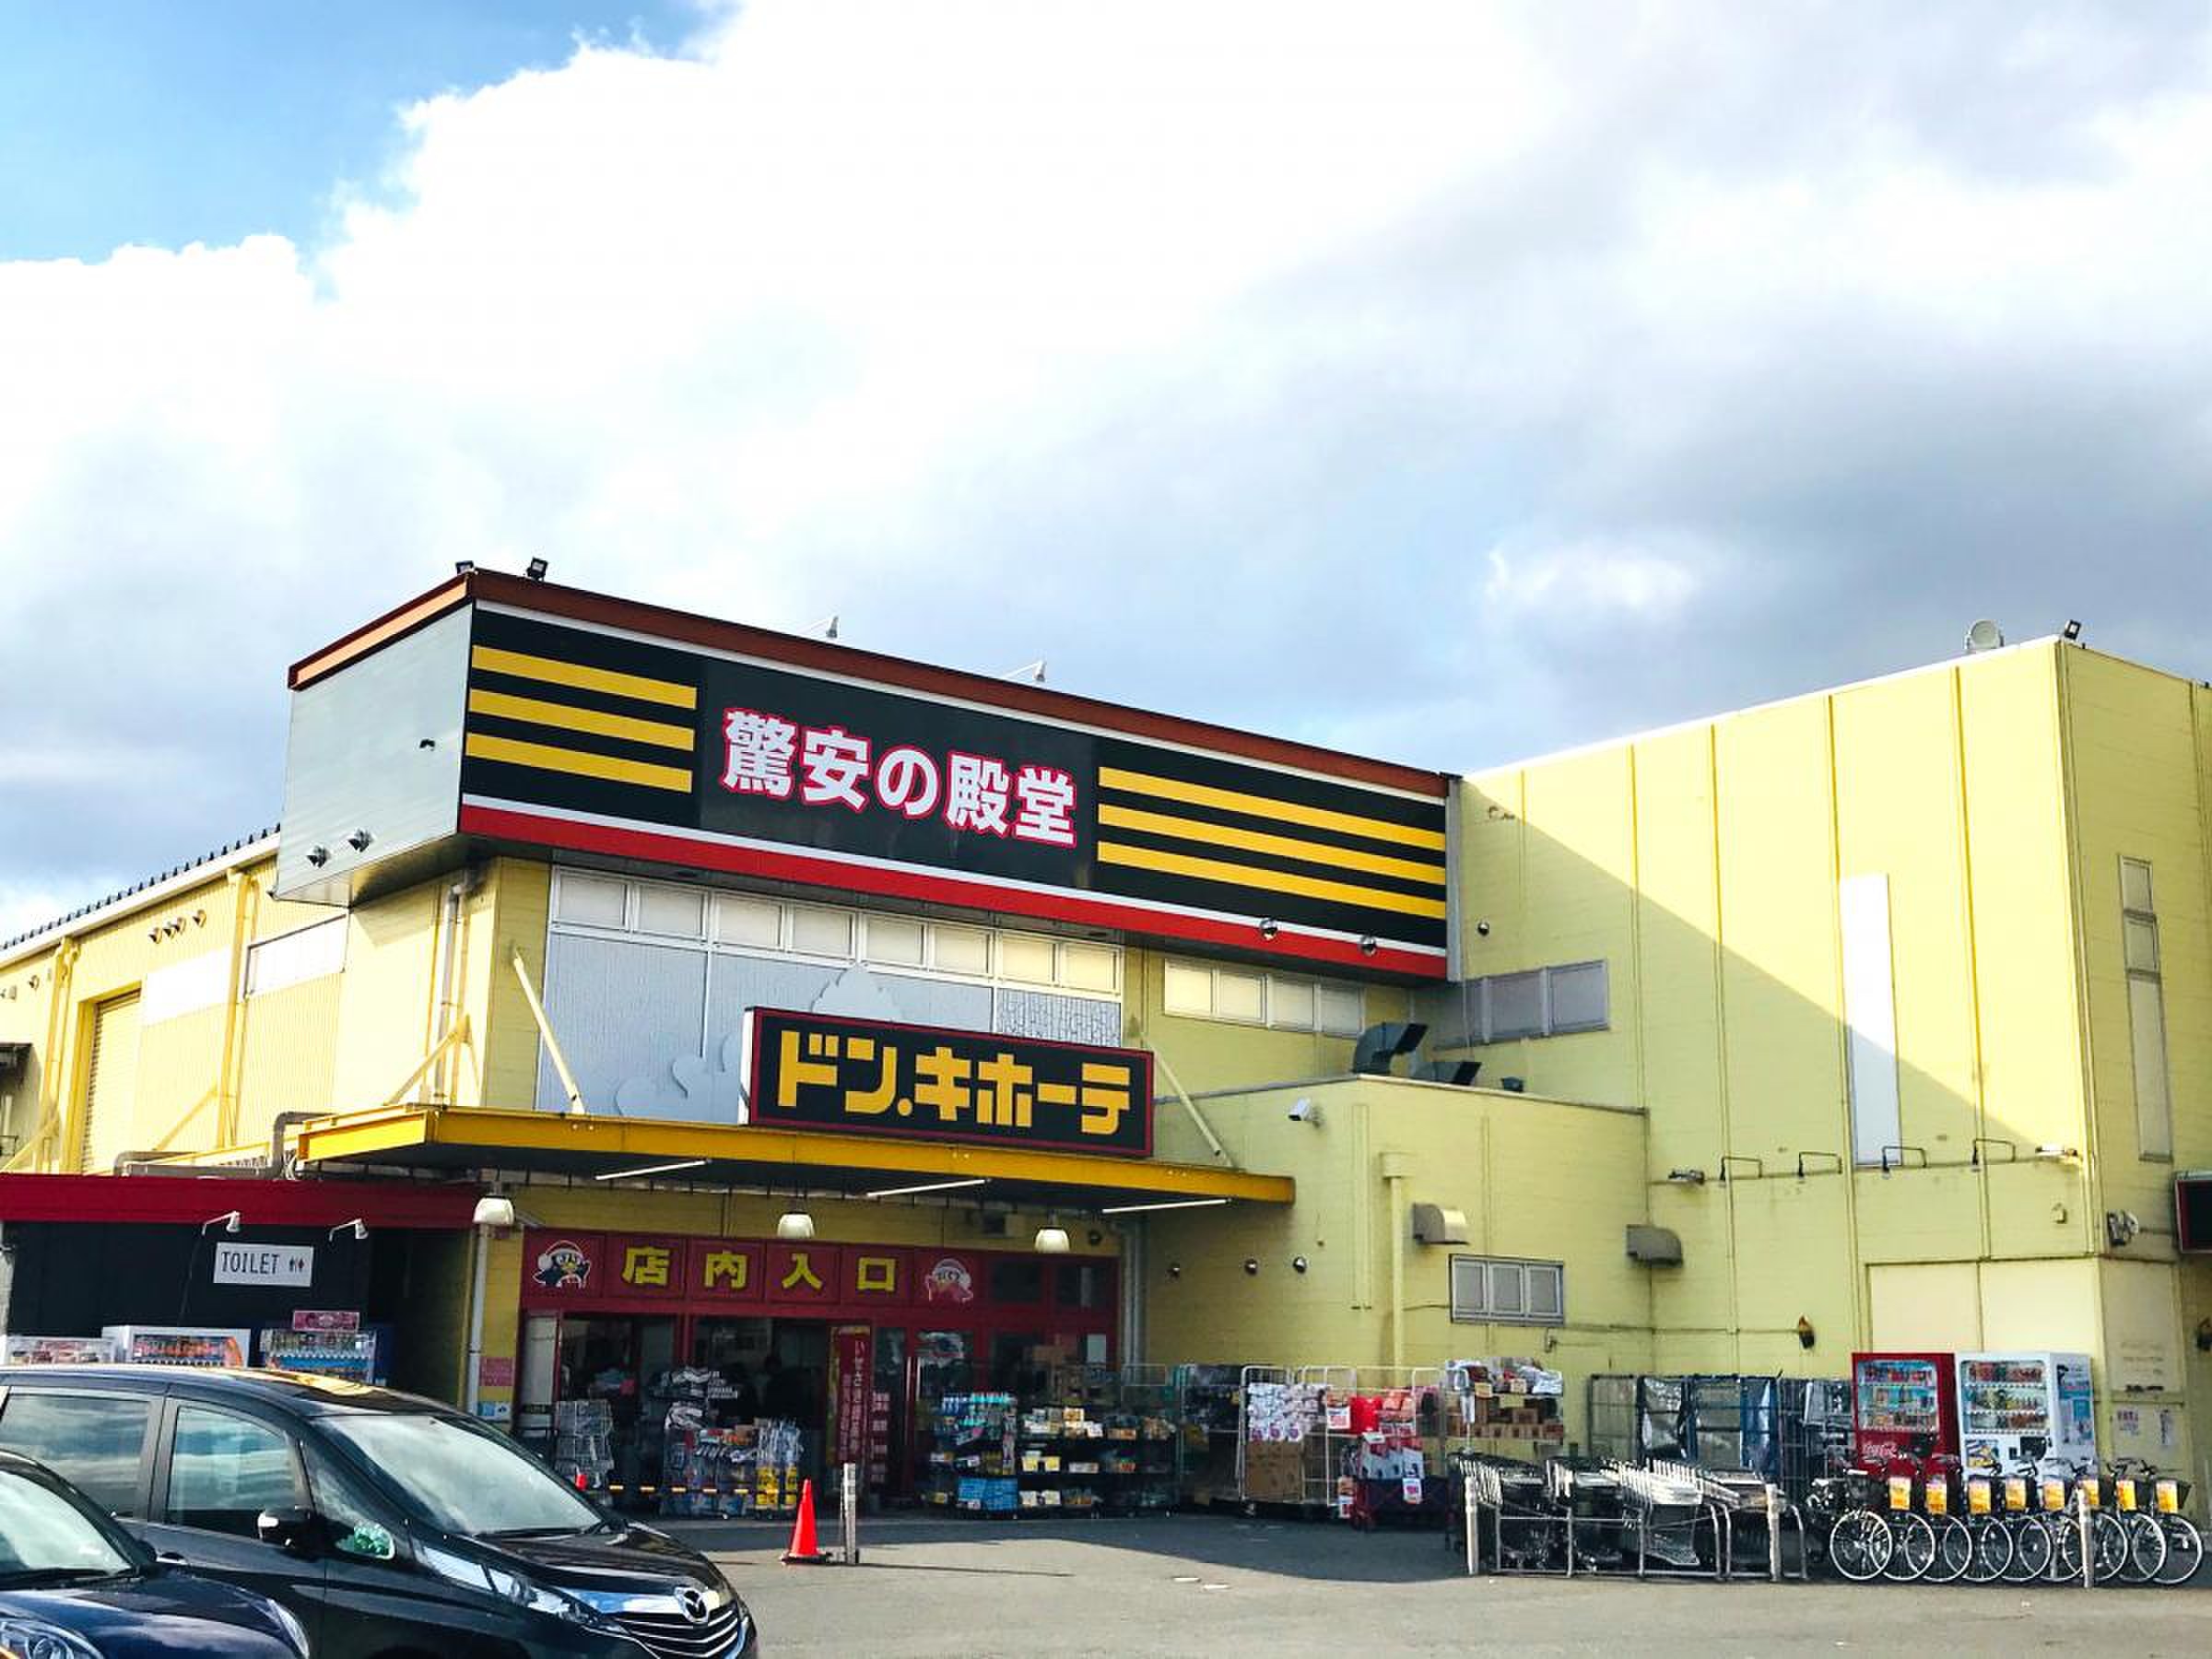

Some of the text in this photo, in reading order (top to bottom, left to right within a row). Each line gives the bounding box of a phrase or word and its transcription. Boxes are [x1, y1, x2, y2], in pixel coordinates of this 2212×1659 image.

[723, 708, 1076, 847] 驚安の殿堂
[221, 1252, 280, 1275] TOILET
[621, 1247, 898, 1291] 店内入口
